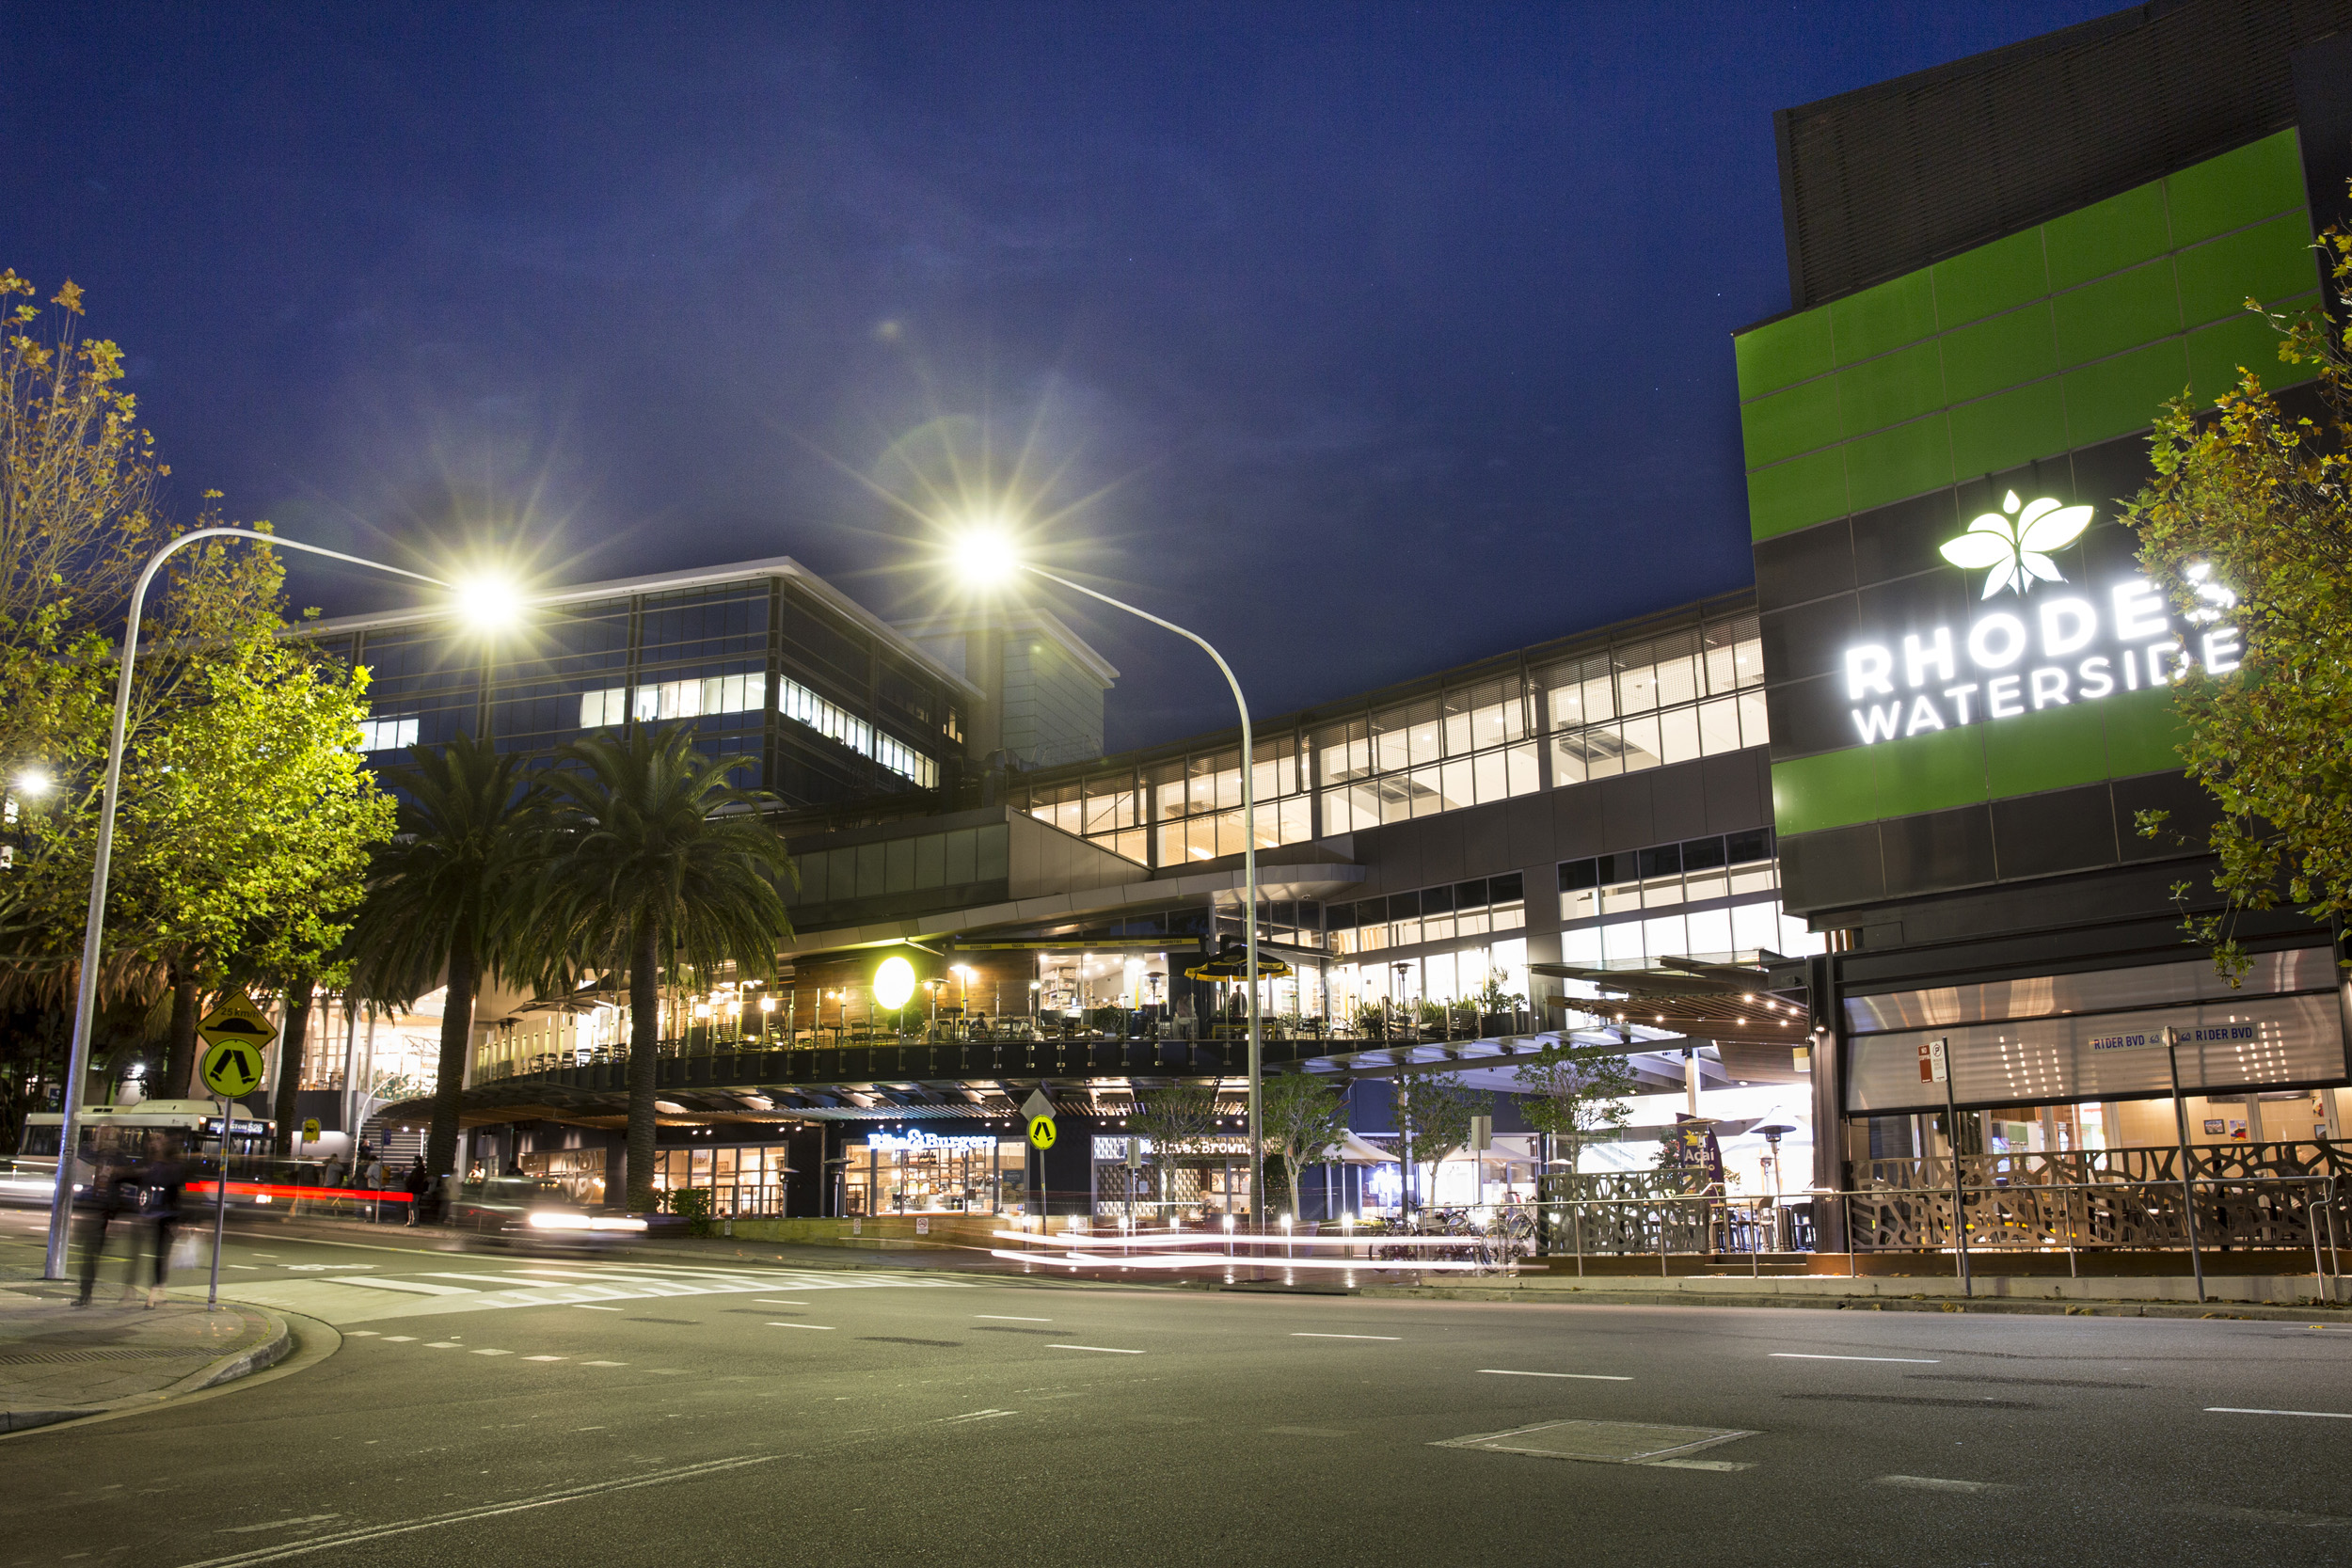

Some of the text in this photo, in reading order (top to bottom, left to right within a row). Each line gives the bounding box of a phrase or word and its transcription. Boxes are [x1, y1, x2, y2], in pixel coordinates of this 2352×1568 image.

[1846, 562, 2236, 700] RHODES
[1851, 626, 2241, 744] WATERSIDE
[220, 1006, 260, 1019] 25 km/h
[2196, 1026, 2252, 1041] RIDER BVD
[2094, 1035, 2145, 1050] RIDER BVD
[247, 1123, 263, 1133] 526
[923, 1132, 997, 1152] Burgers
